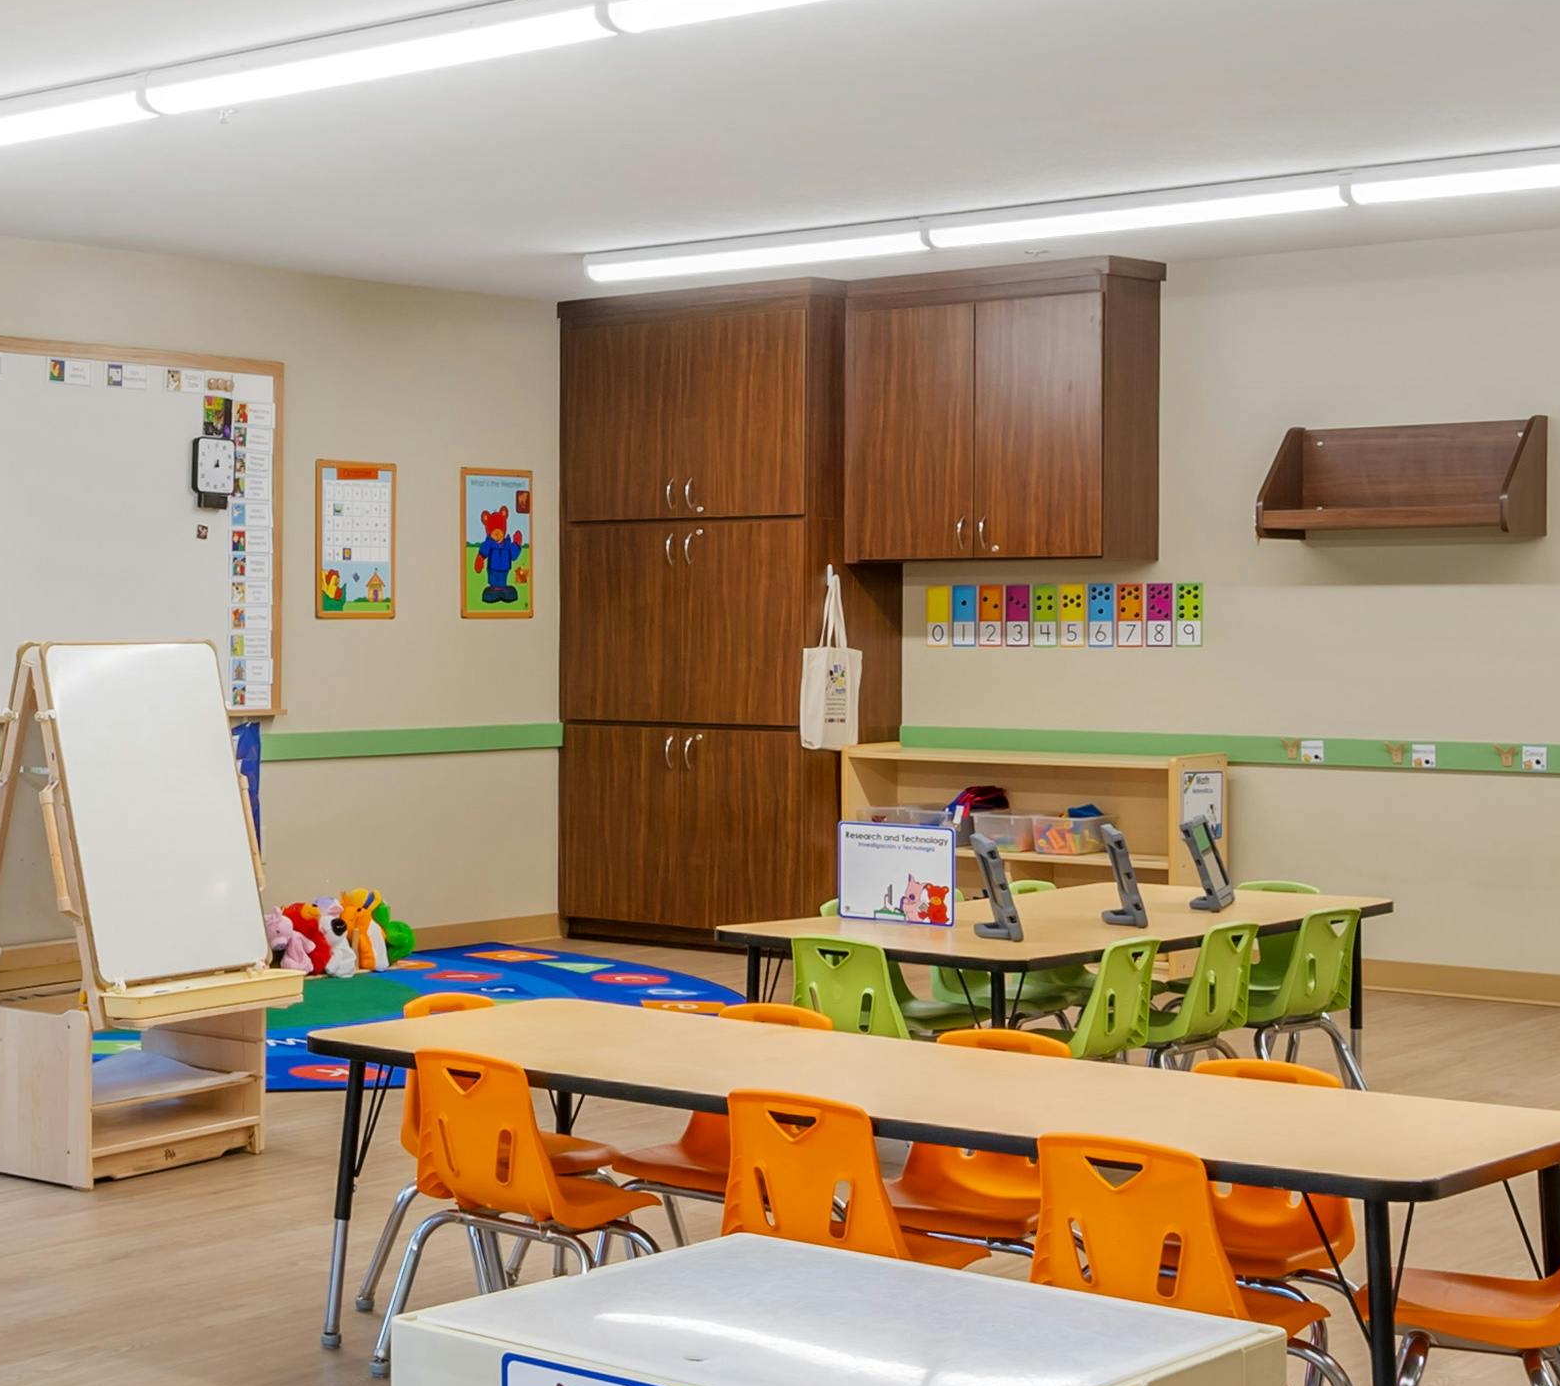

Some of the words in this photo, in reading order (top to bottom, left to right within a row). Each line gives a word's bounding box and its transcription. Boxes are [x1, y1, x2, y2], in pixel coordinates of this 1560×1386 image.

[931, 624, 944, 642] 0
[985, 624, 996, 642] 2
[1012, 624, 1023, 642] 3
[1039, 624, 1051, 642] 4
[1066, 624, 1078, 642] 5
[1095, 624, 1107, 642] 6
[1125, 624, 1136, 642] 7
[1153, 624, 1165, 642] 8
[1183, 624, 1195, 642] 9
[845, 831, 882, 841] Research
[883, 834, 900, 843] and
[902, 834, 949, 847] Technology
